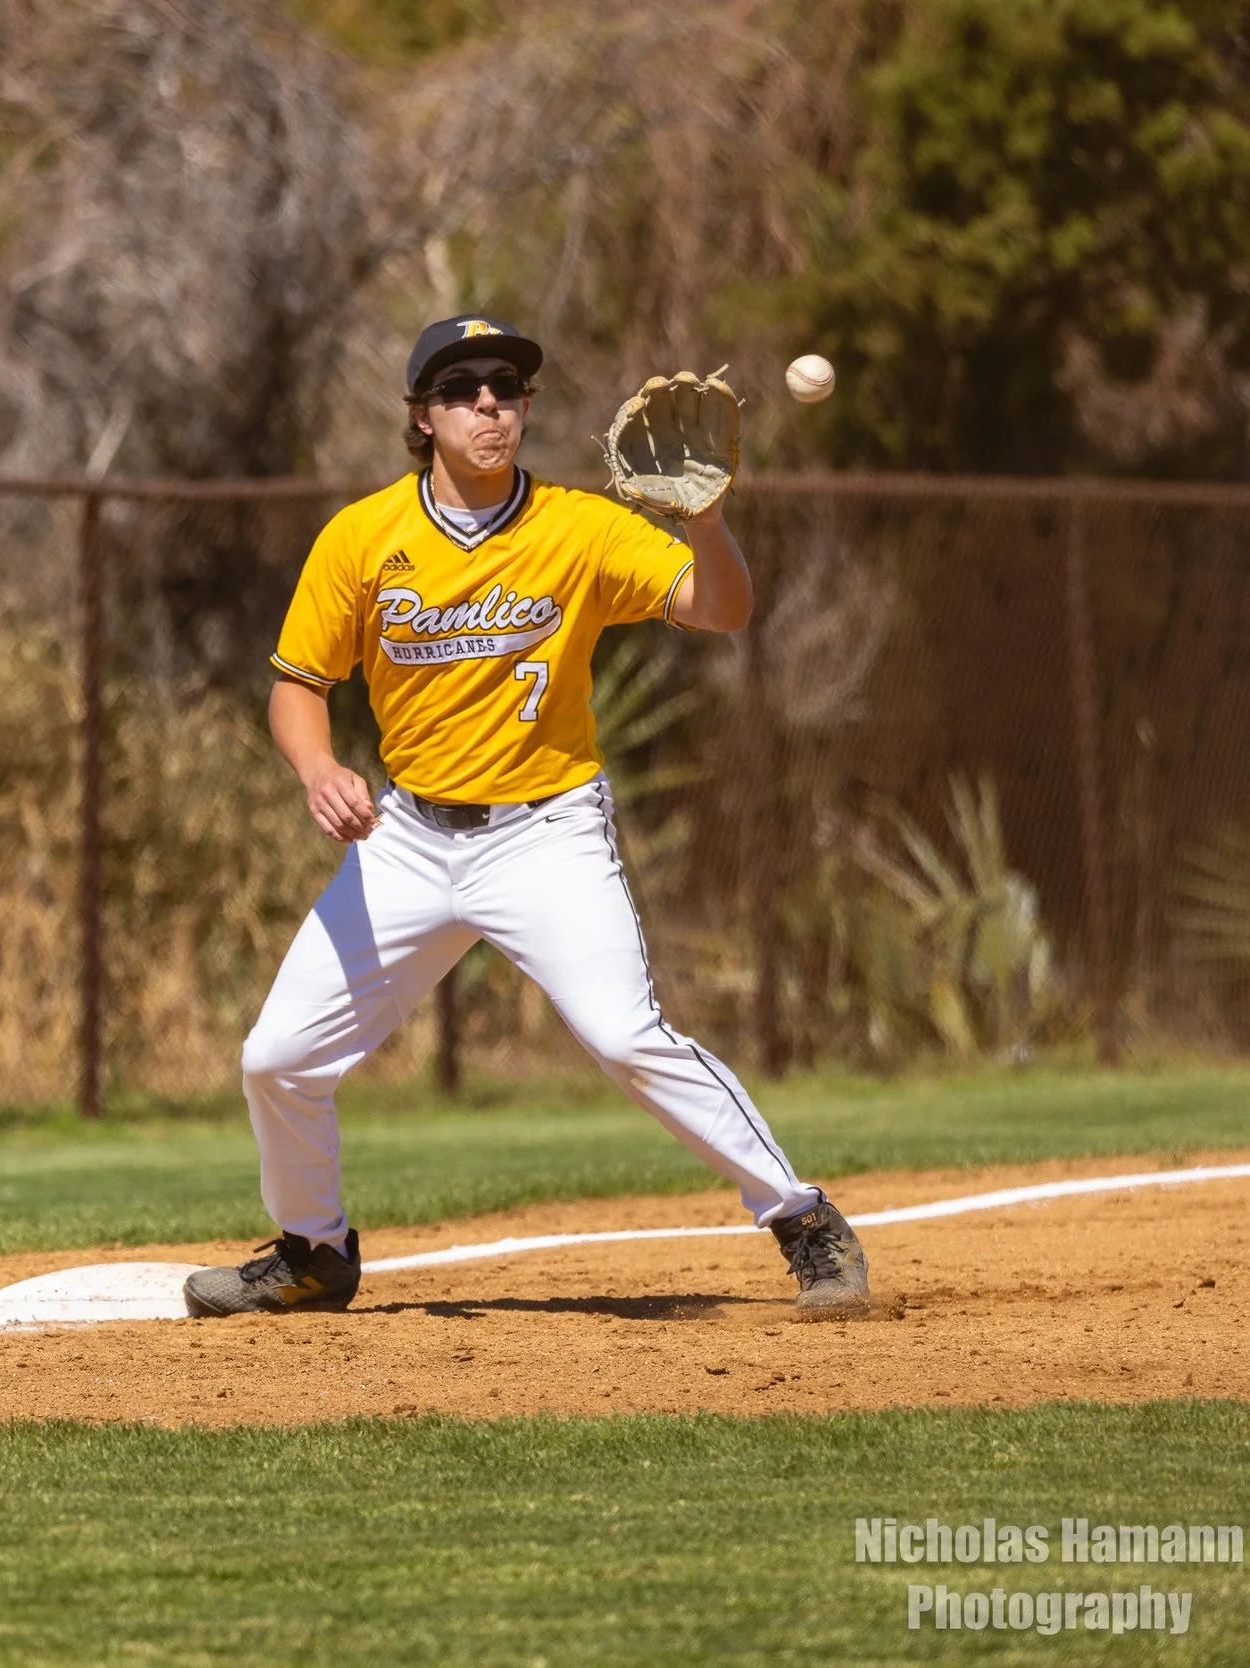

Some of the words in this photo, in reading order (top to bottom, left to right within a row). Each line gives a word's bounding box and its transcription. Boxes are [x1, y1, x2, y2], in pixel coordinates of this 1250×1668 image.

[382, 563, 416, 572] adidas
[377, 583, 556, 635] Pamlico
[391, 638, 497, 661] HURRICANES
[514, 660, 549, 722] 7
